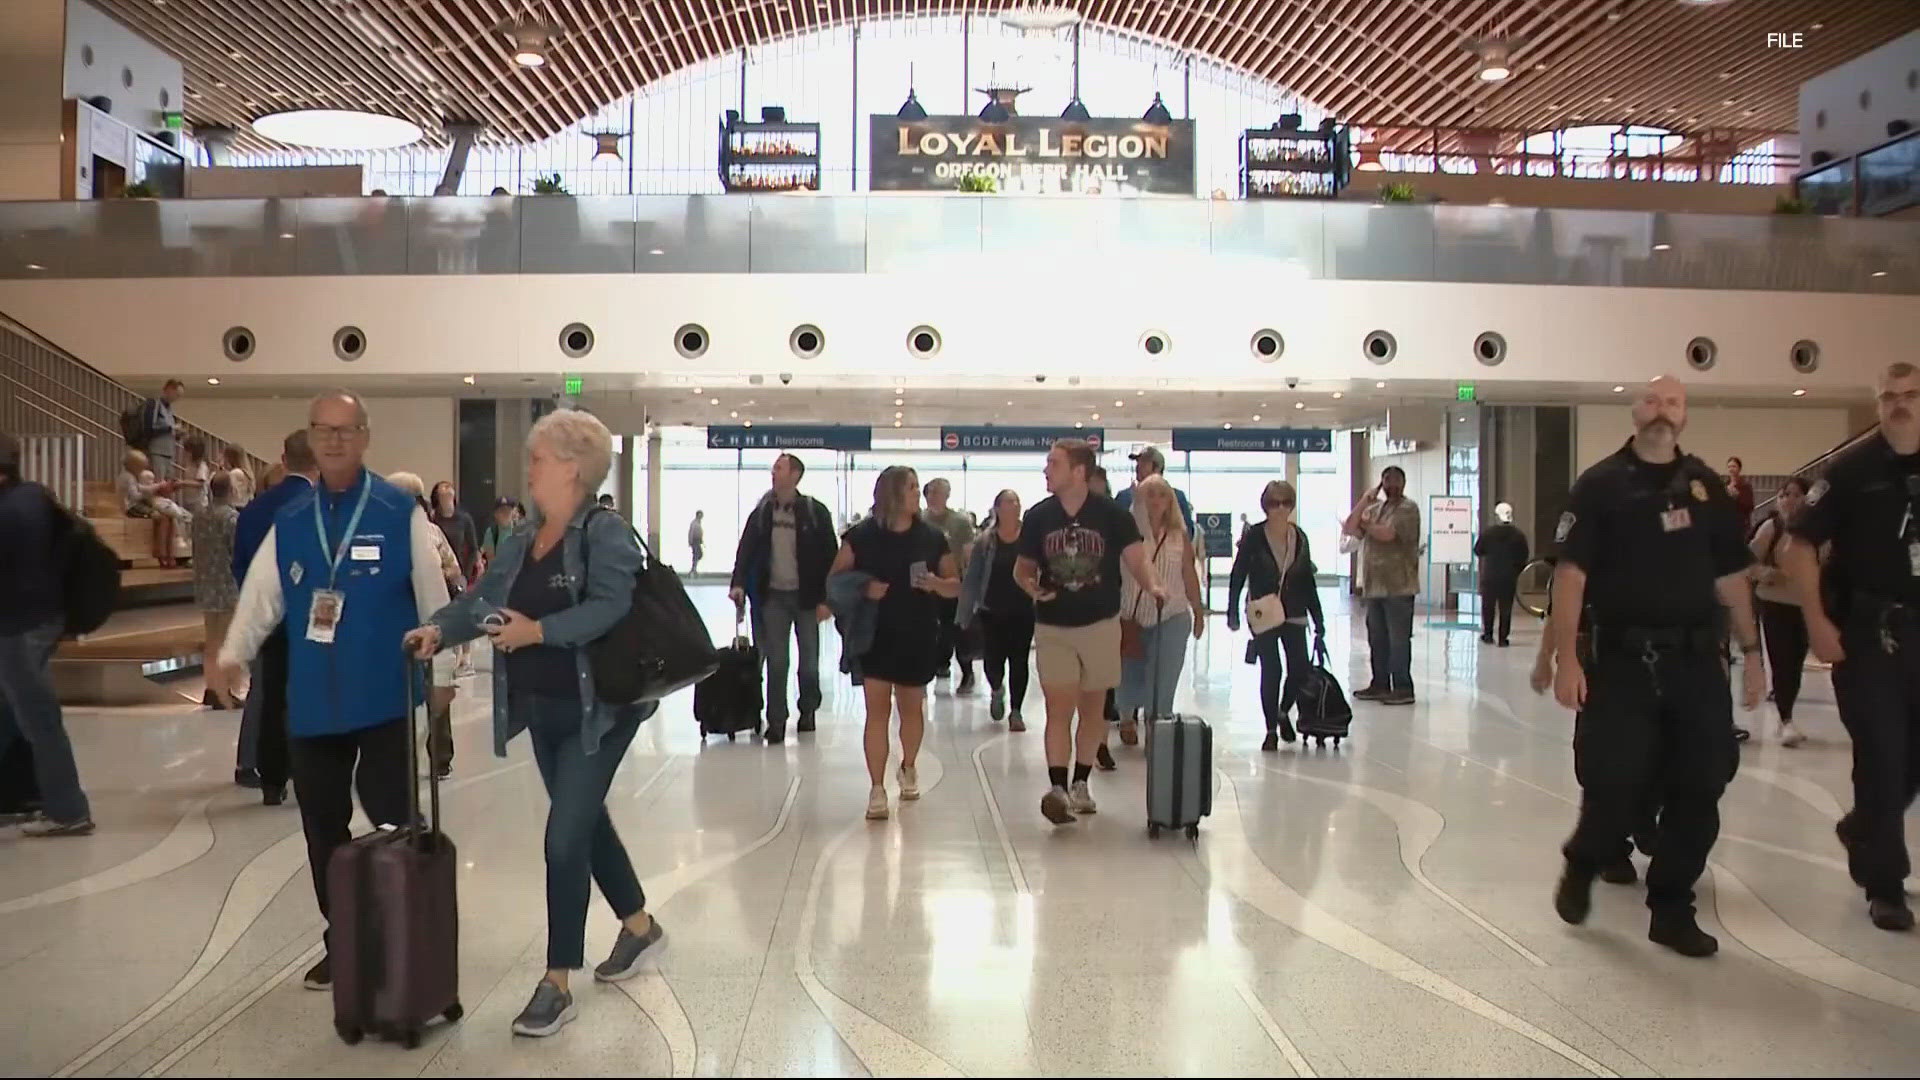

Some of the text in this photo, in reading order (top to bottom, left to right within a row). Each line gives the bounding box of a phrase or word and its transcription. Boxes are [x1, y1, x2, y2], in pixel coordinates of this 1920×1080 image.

[898, 127, 1169, 158] LOYAL LEGION
[935, 162, 1012, 178] OREGON
[1075, 164, 1129, 181] HALL
[565, 380, 582, 395] EXIT
[775, 434, 825, 446] Restrooms
[1001, 436, 1035, 447] Arrivals
[1217, 438, 1265, 448] Restrooms
